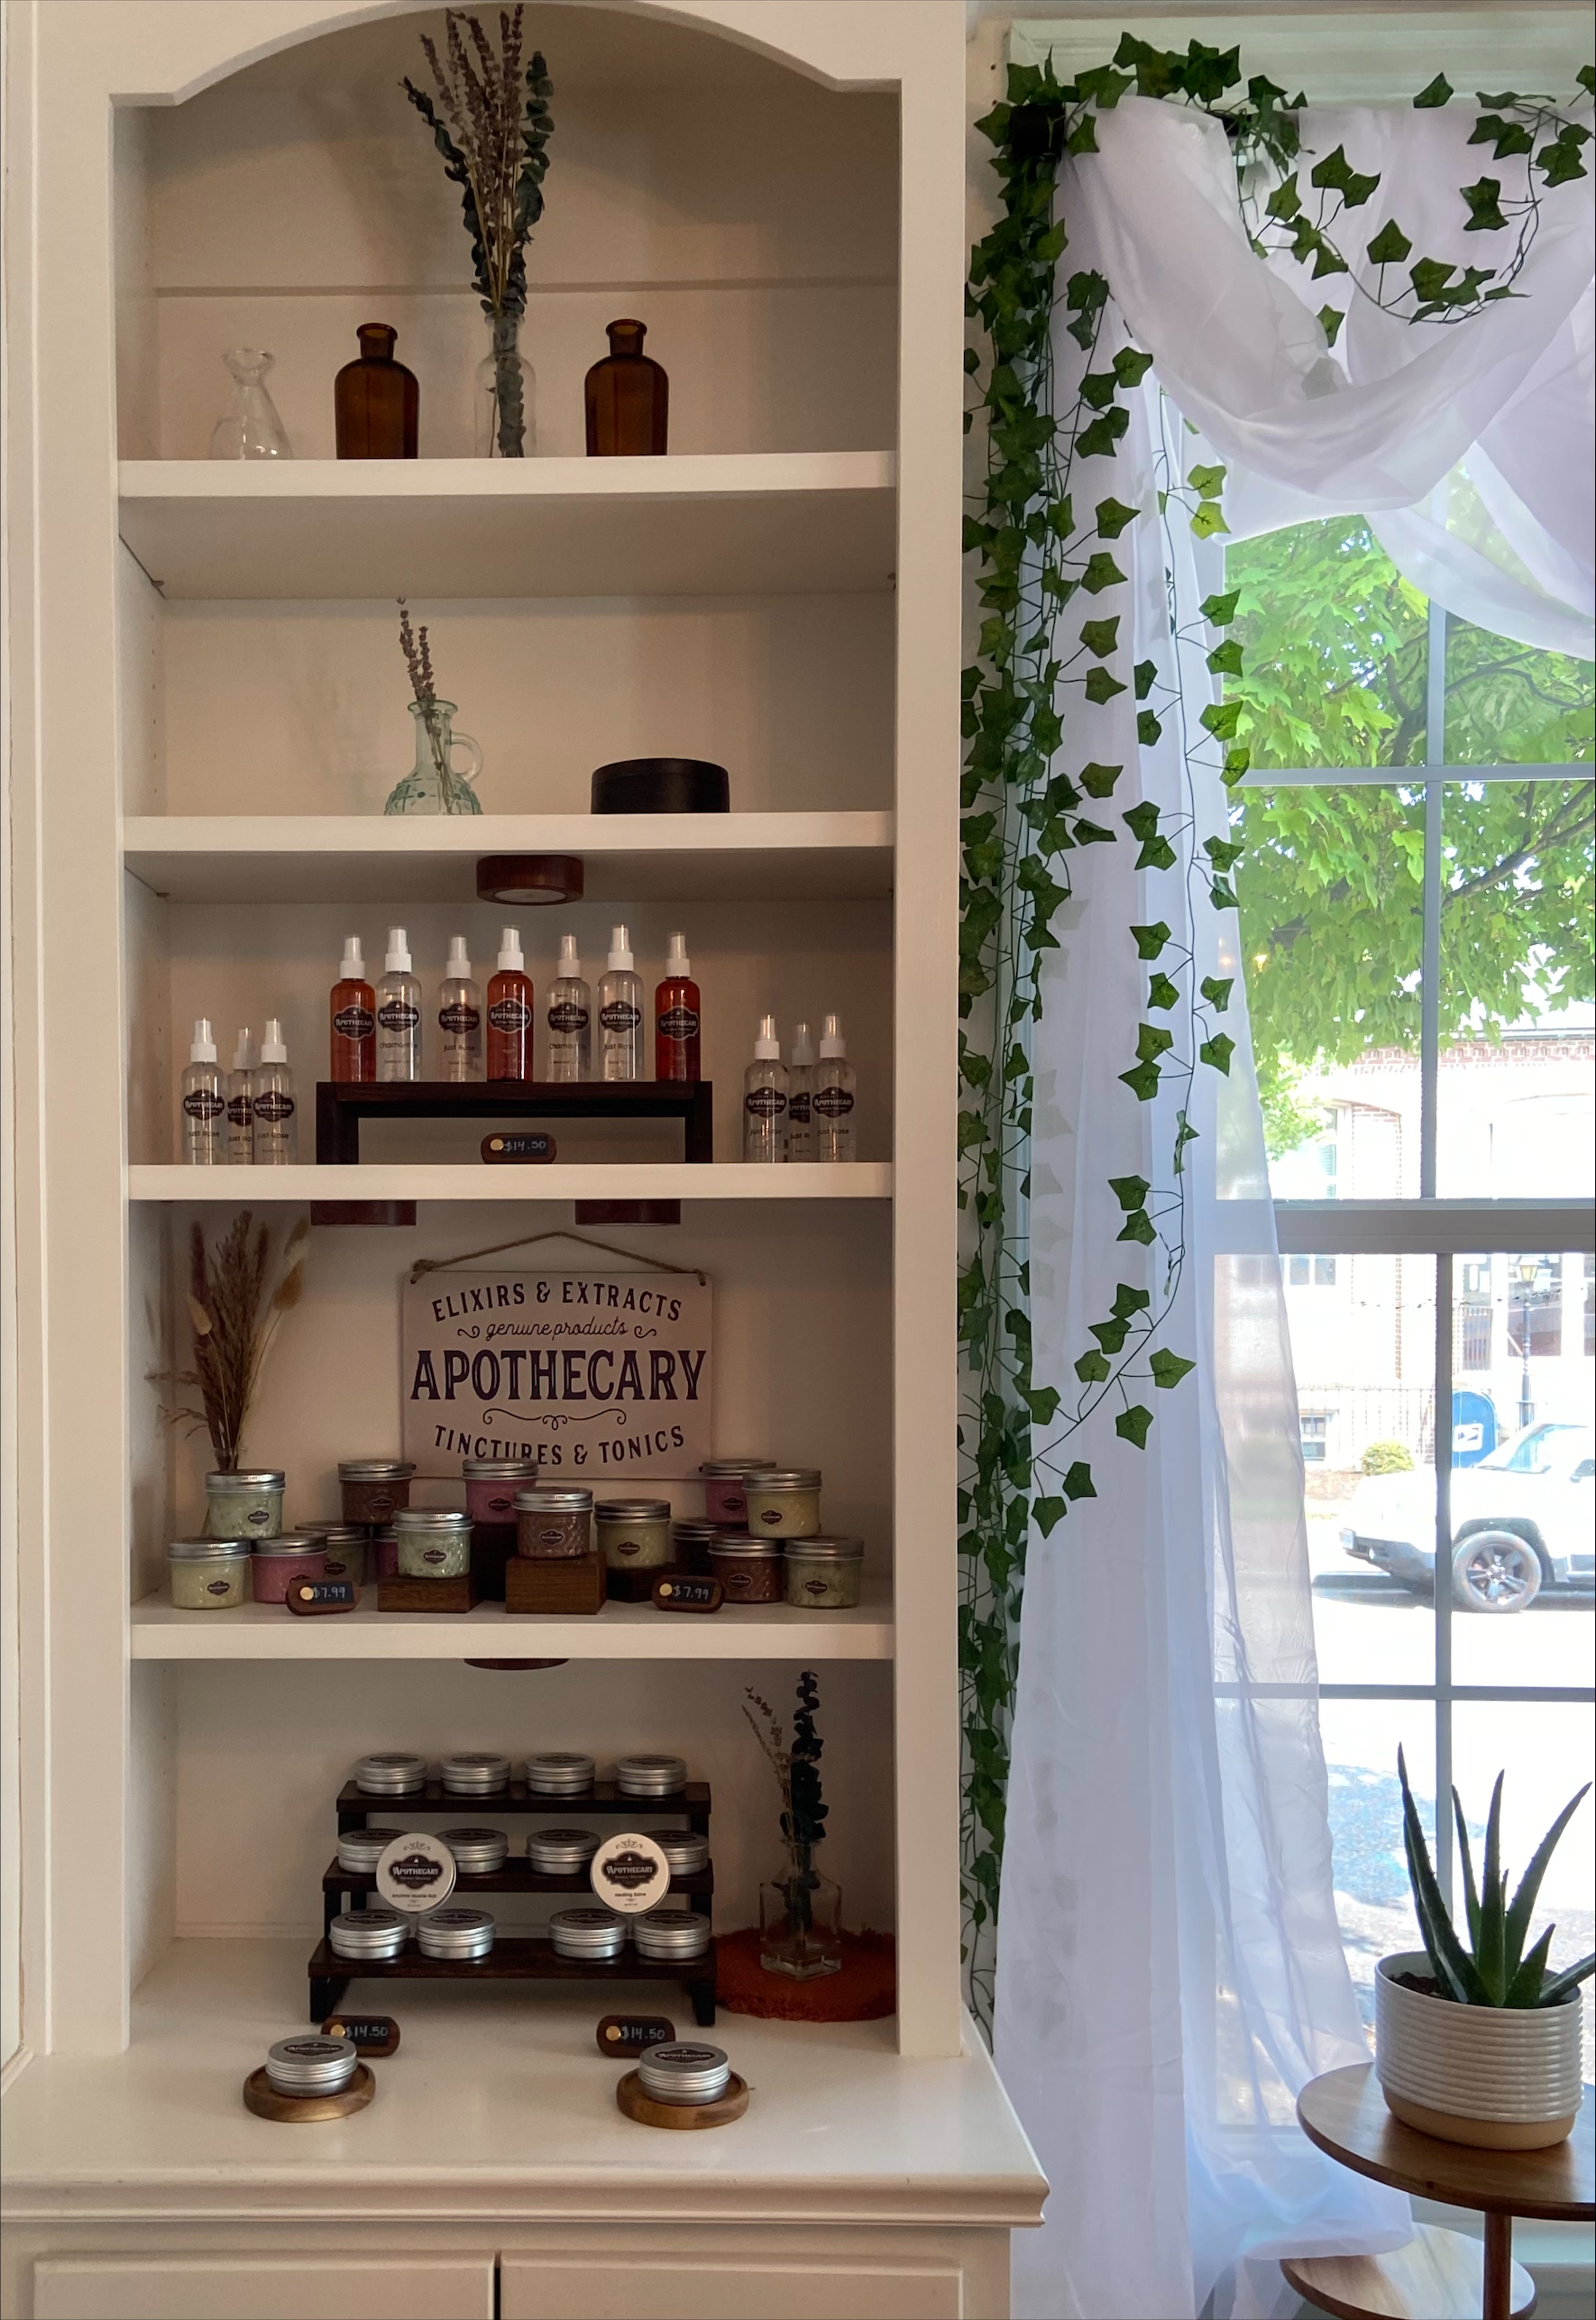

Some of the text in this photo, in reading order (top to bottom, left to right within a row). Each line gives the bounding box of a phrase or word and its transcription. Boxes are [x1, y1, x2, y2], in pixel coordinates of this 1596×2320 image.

[380, 1041, 418, 1050] Chamome
[503, 1141, 546, 1152] $14.50
[432, 1281, 683, 1322] ELIXIRS & EXTRACTS
[485, 1316, 628, 1342] genuine products
[410, 1350, 707, 1400] APOTHECARY
[434, 1425, 684, 1465] TINCTURES & TONICS
[312, 1586, 346, 1599] $7.99
[673, 1584, 710, 1600] $7.99
[345, 2025, 389, 2038] $14.50
[619, 2026, 665, 2040] $14.50
